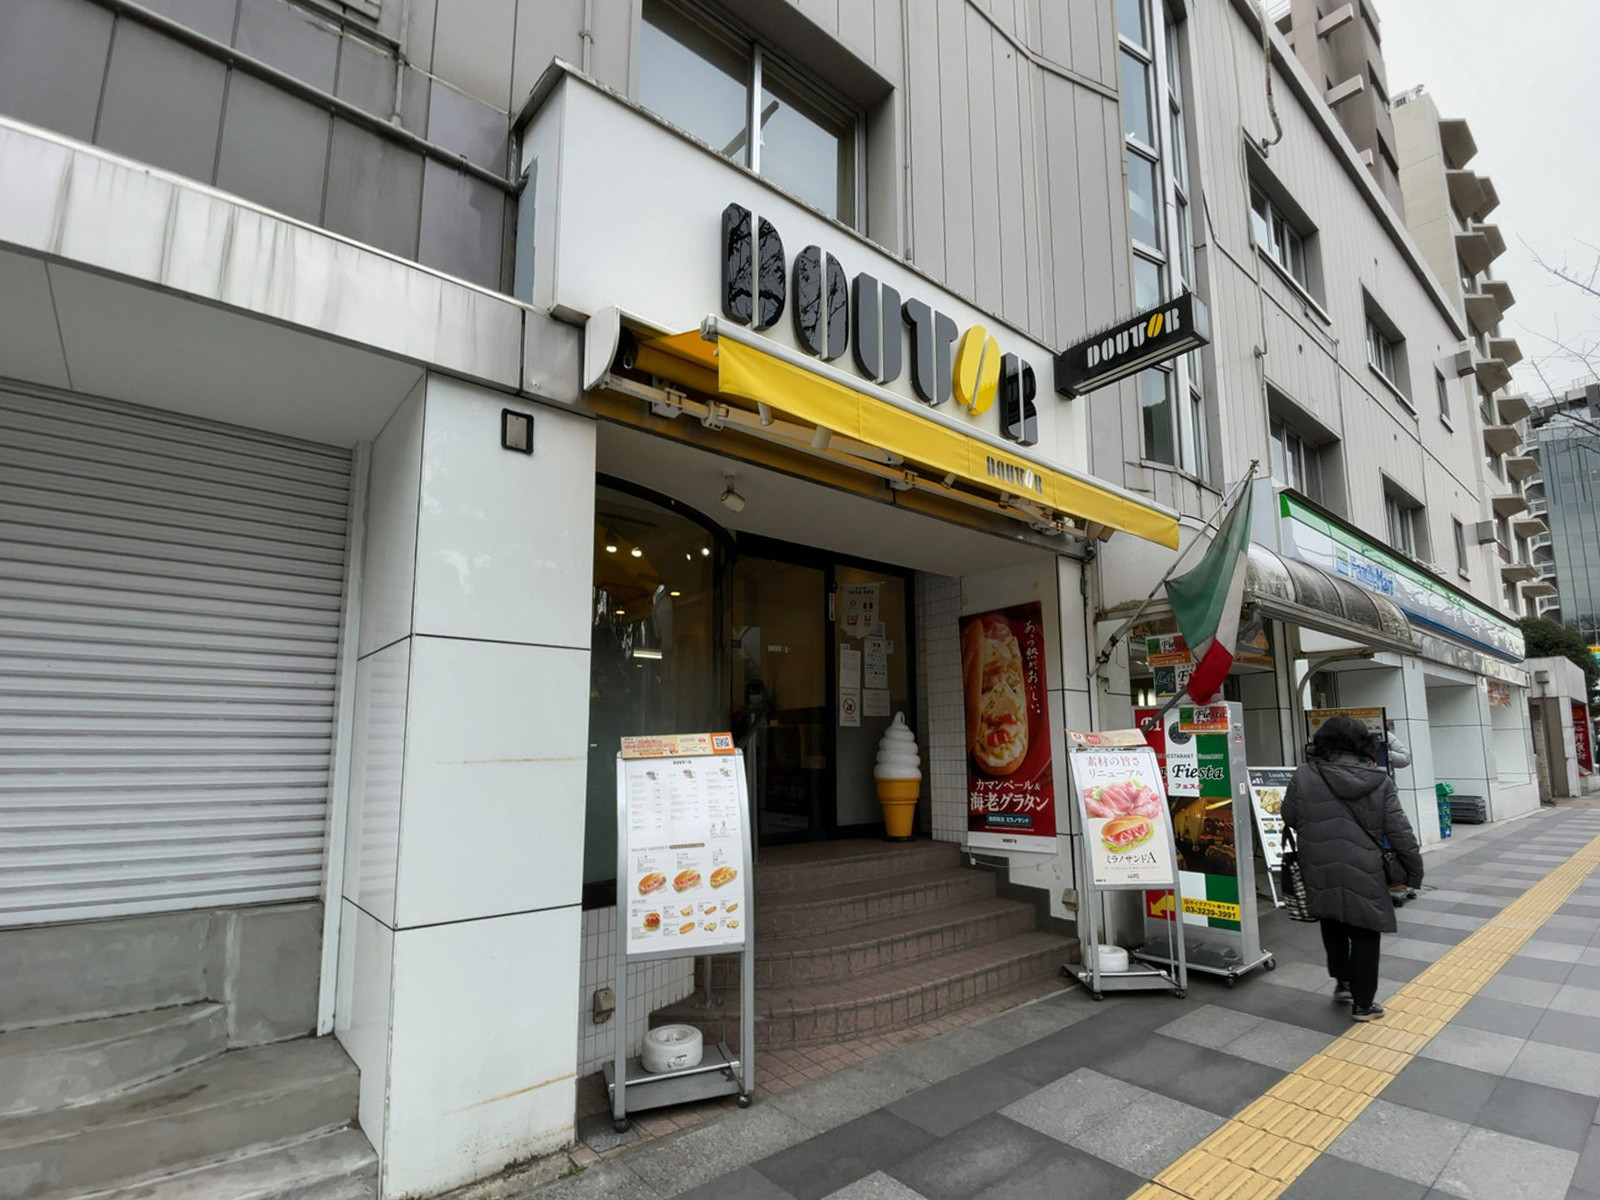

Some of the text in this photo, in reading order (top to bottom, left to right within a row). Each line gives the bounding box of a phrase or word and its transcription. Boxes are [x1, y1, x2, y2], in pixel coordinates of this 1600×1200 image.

[721, 202, 1038, 446] DOUTOR
[1086, 307, 1181, 369] DOUTOR
[985, 455, 1044, 496] DOUTOR
[1156, 671, 1175, 684] La
[1087, 756, 1141, 767] 素材の旨さ
[1088, 769, 1145, 779] リニューアル
[1171, 763, 1225, 780] Fiesta
[970, 792, 1050, 812] 海老グラタン
[1105, 852, 1157, 865] ミラノサンドA
[1185, 906, 1236, 919] 03-3239-3991
